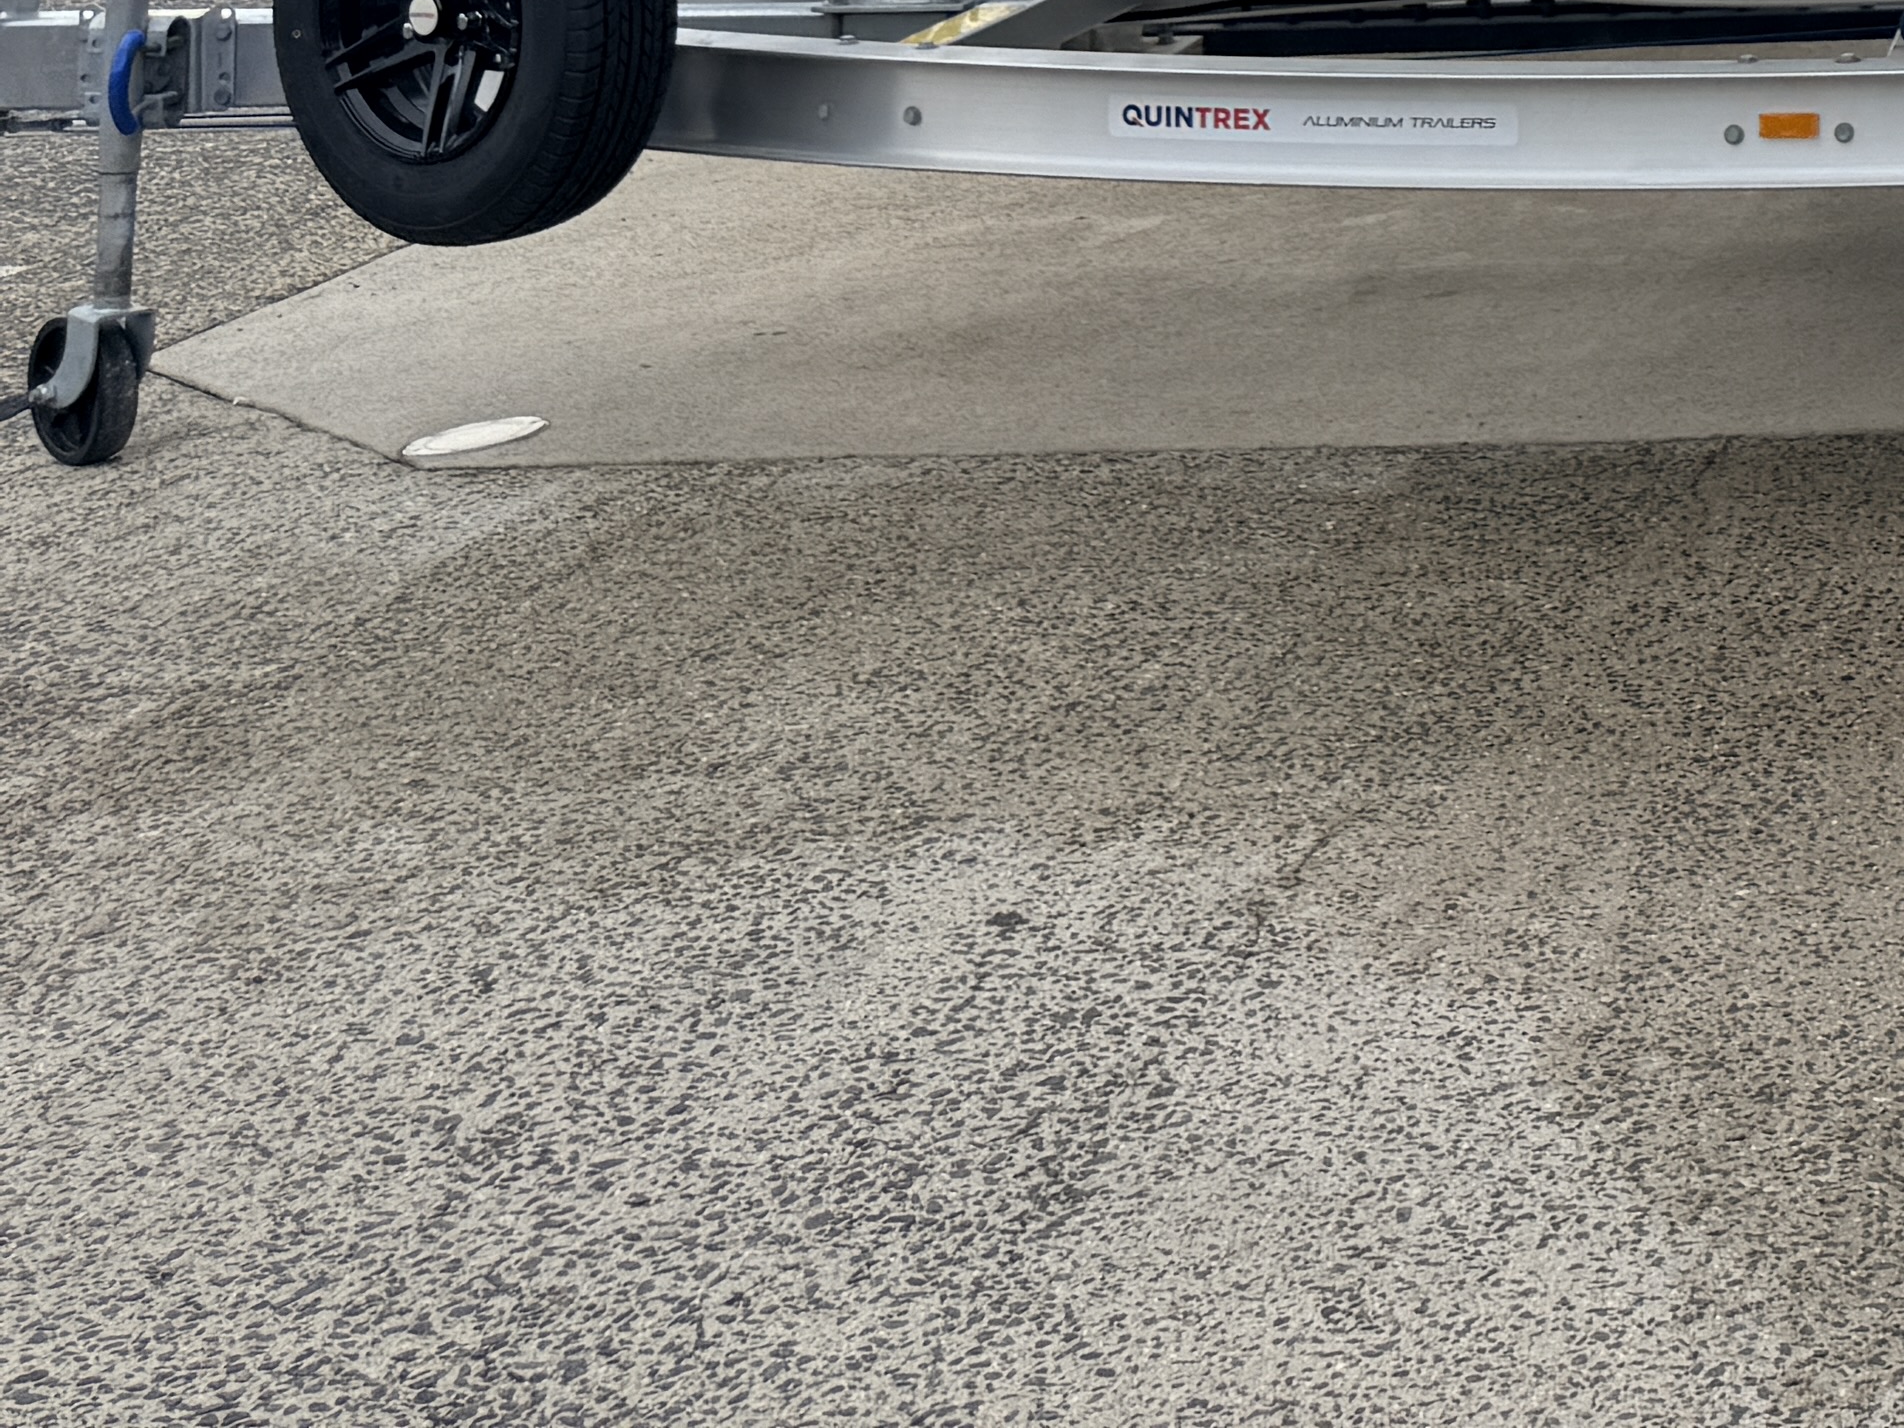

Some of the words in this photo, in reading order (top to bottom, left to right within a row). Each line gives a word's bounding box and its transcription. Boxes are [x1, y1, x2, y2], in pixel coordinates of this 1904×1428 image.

[1122, 104, 1272, 131] QUINTREX
[1302, 115, 1404, 129] ALUMINIUM
[1409, 116, 1497, 130] TRAILERS
